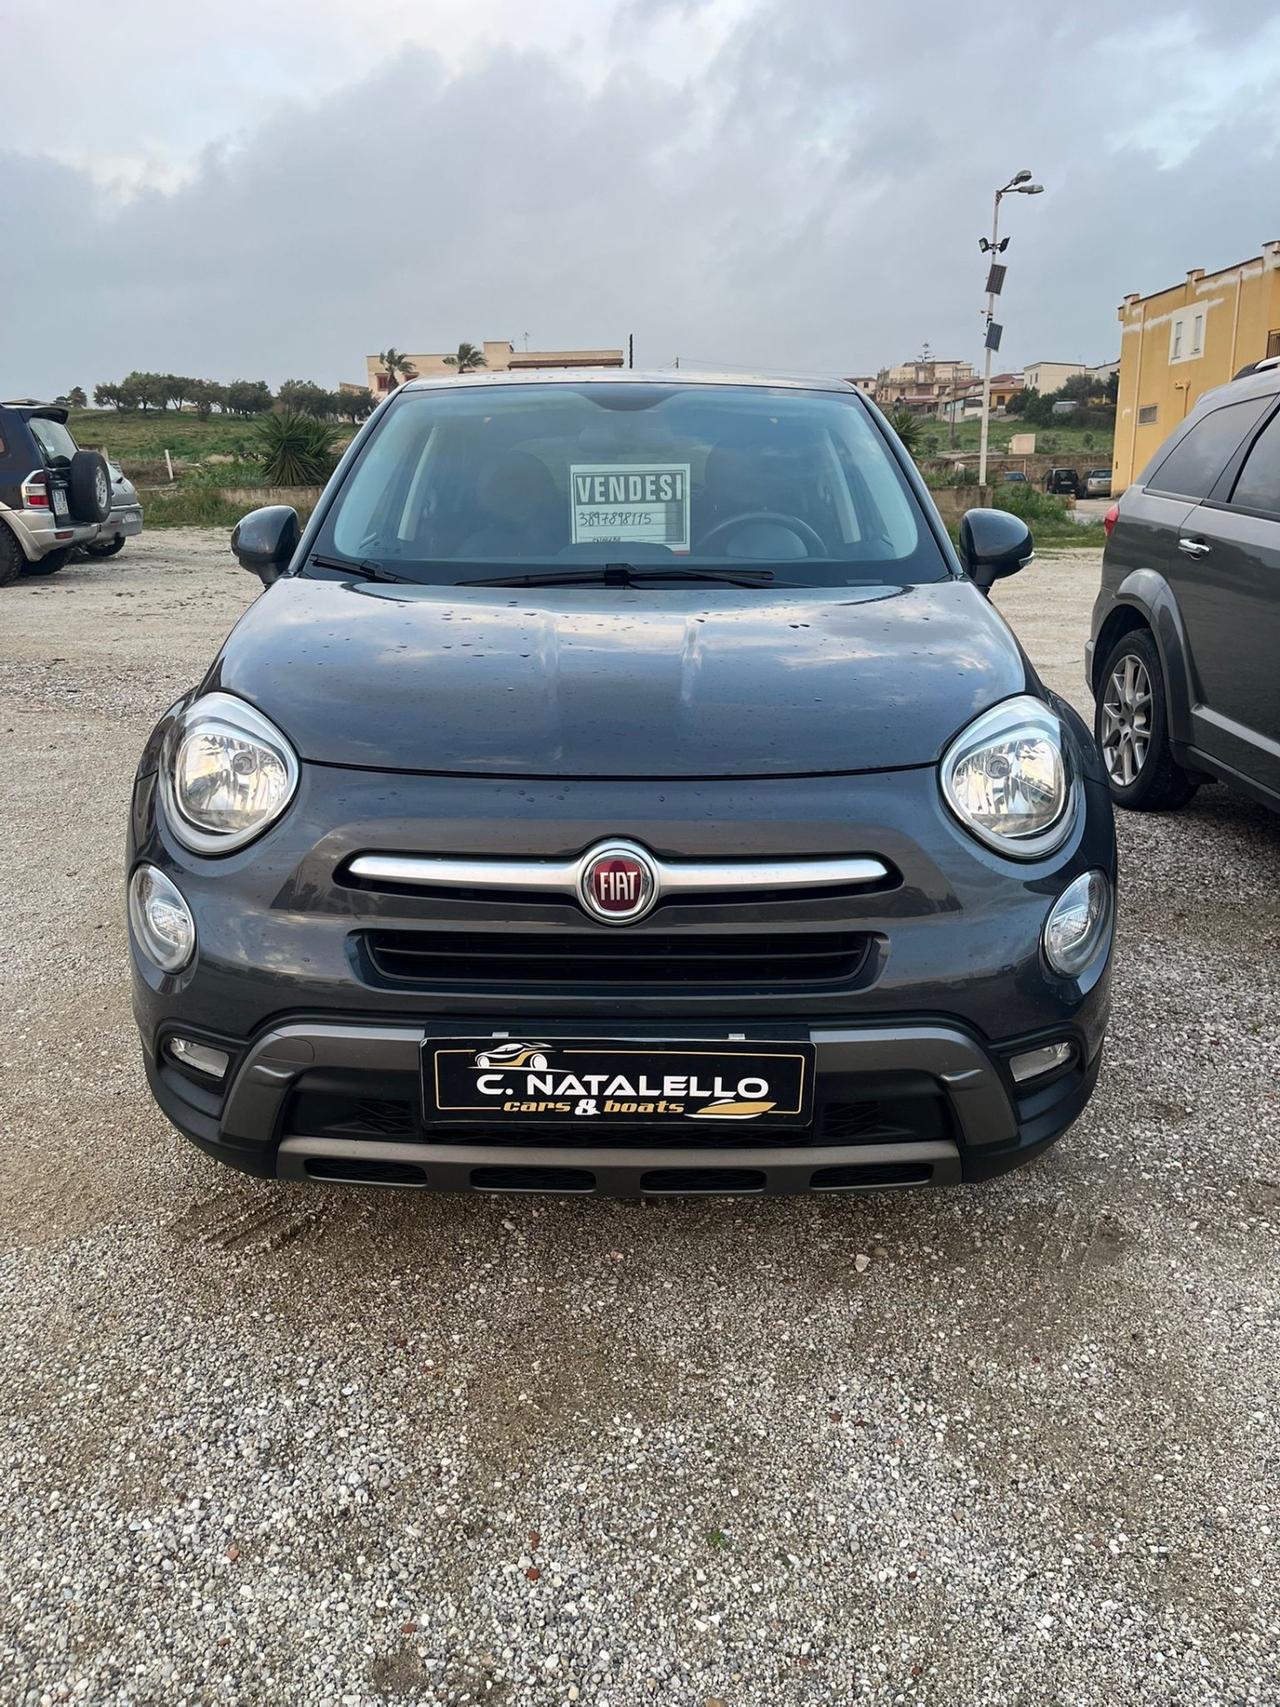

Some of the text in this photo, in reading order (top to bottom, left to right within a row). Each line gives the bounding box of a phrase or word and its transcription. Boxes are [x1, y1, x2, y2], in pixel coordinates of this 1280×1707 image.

[576, 474, 682, 503] VENDESI
[599, 871, 638, 901] FIAT
[475, 1074, 769, 1099] C. NATALELLO
